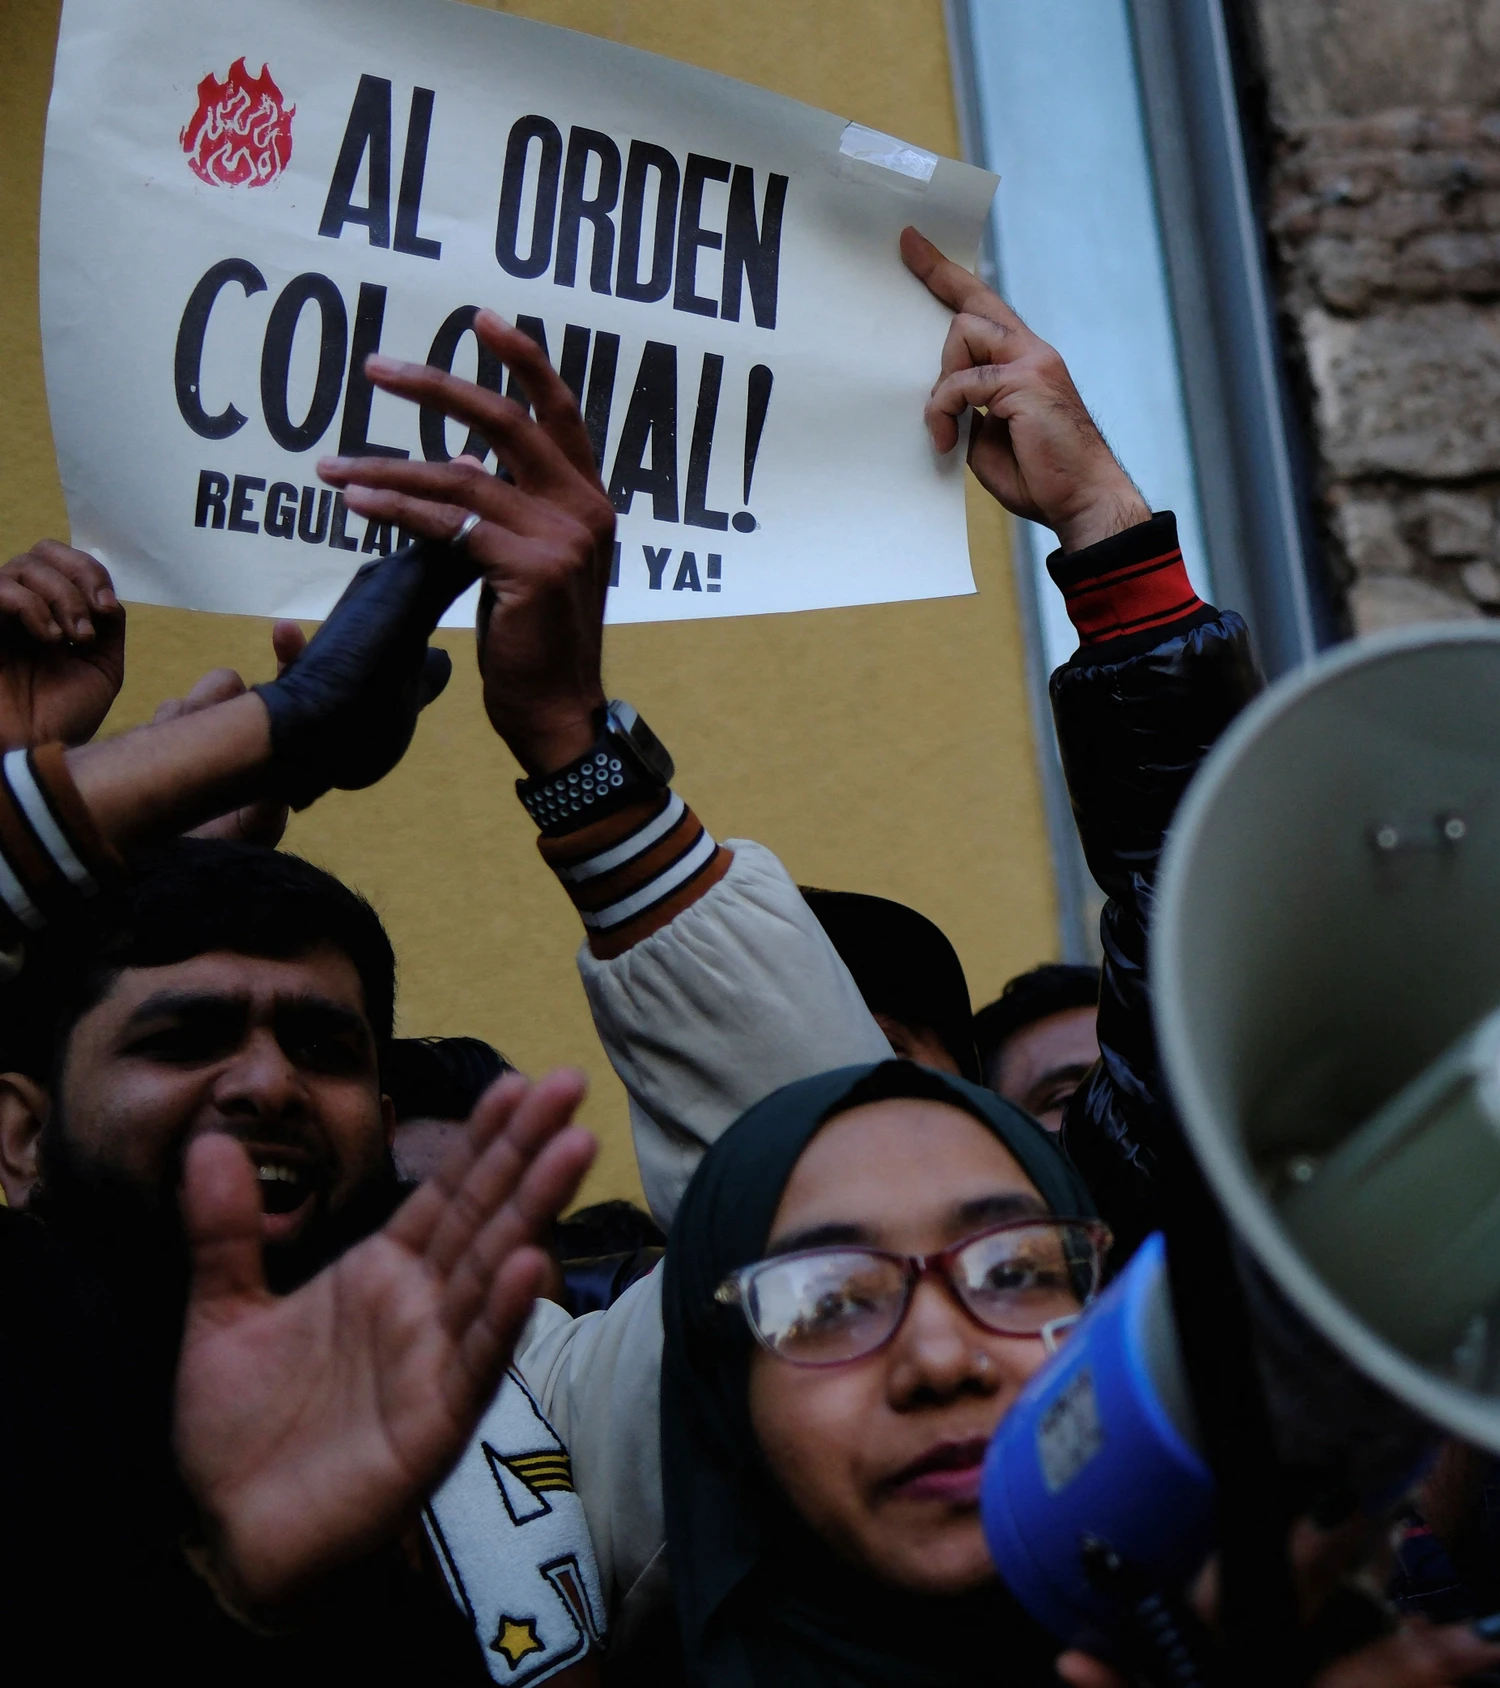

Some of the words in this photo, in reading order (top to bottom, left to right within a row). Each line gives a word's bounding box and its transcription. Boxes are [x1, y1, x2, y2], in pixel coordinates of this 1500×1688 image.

[318, 74, 441, 259] AL
[495, 114, 789, 330] ORDEN
[642, 545, 722, 592] YA!
